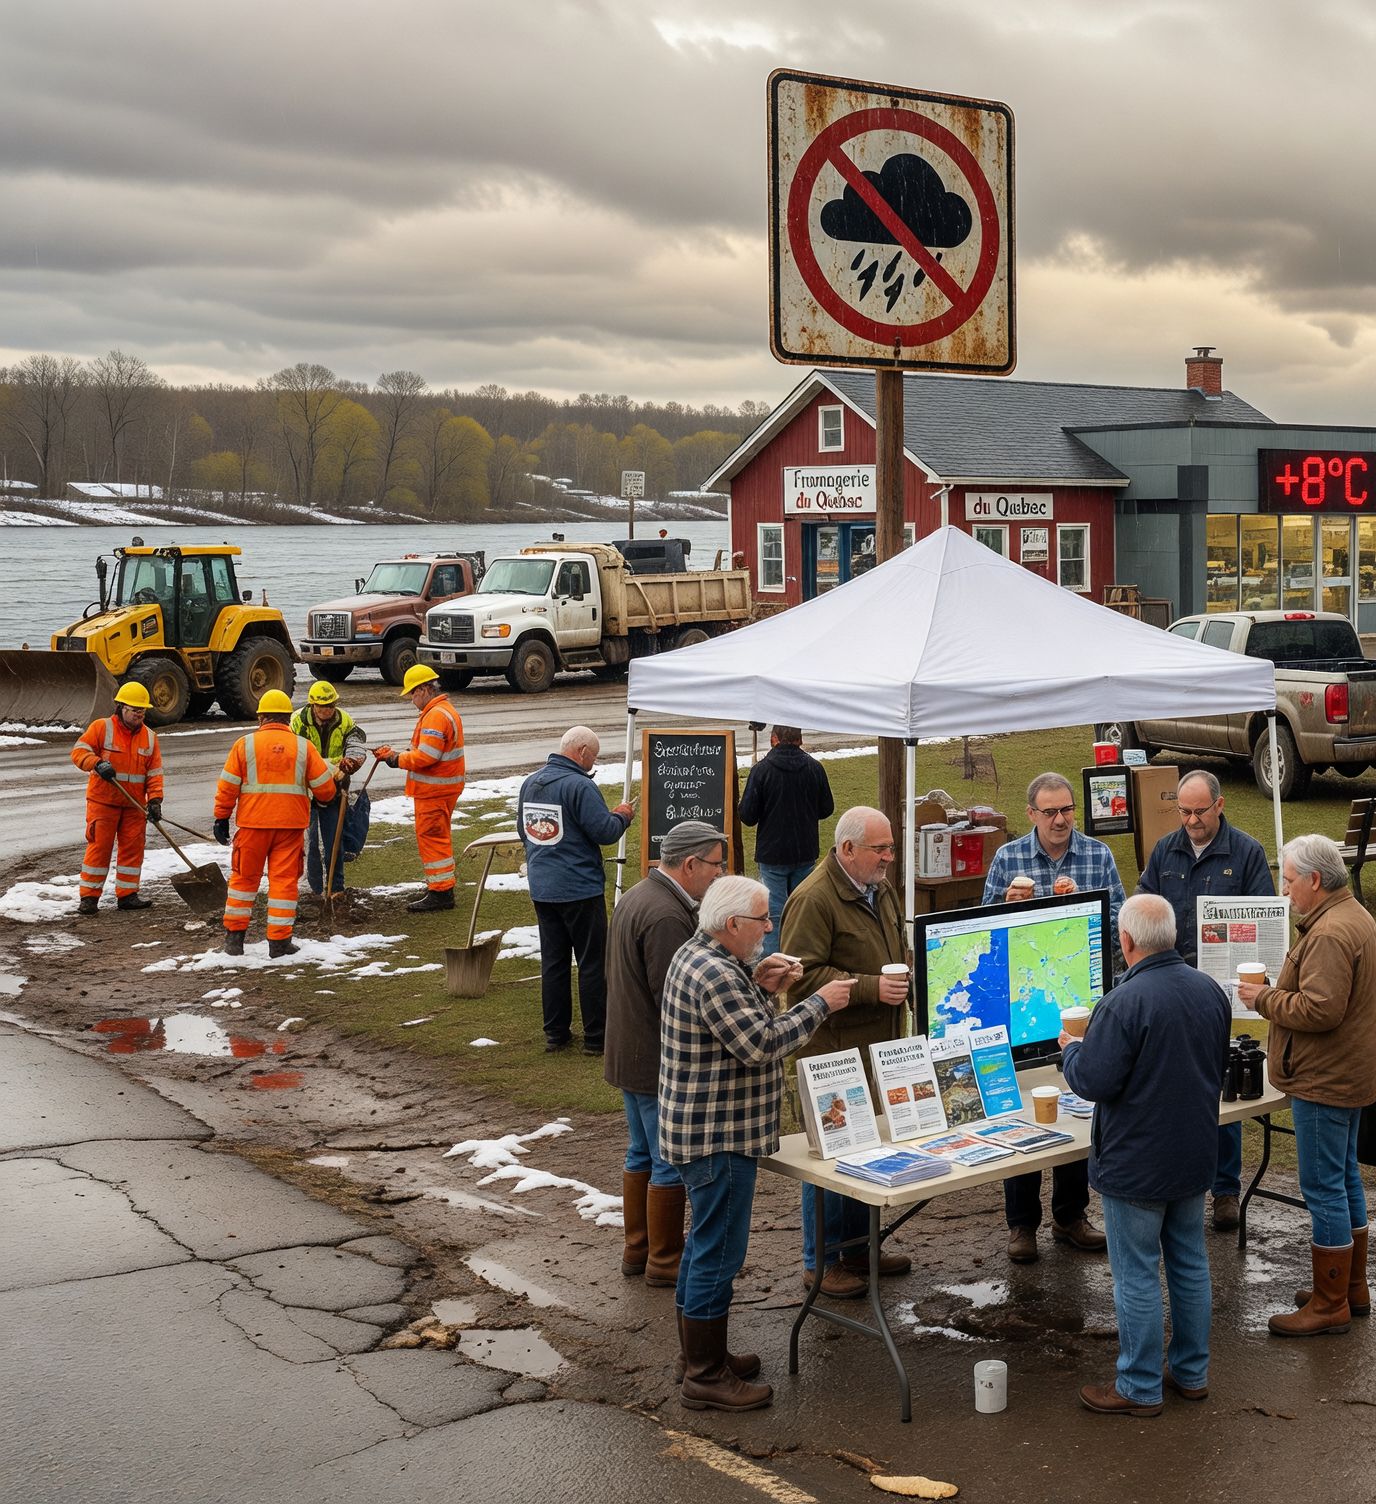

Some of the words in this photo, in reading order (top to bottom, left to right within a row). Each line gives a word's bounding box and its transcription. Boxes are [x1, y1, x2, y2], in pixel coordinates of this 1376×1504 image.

[1275, 457, 1368, 505] +8°C
[796, 491, 811, 509] du
[974, 496, 991, 515] du
